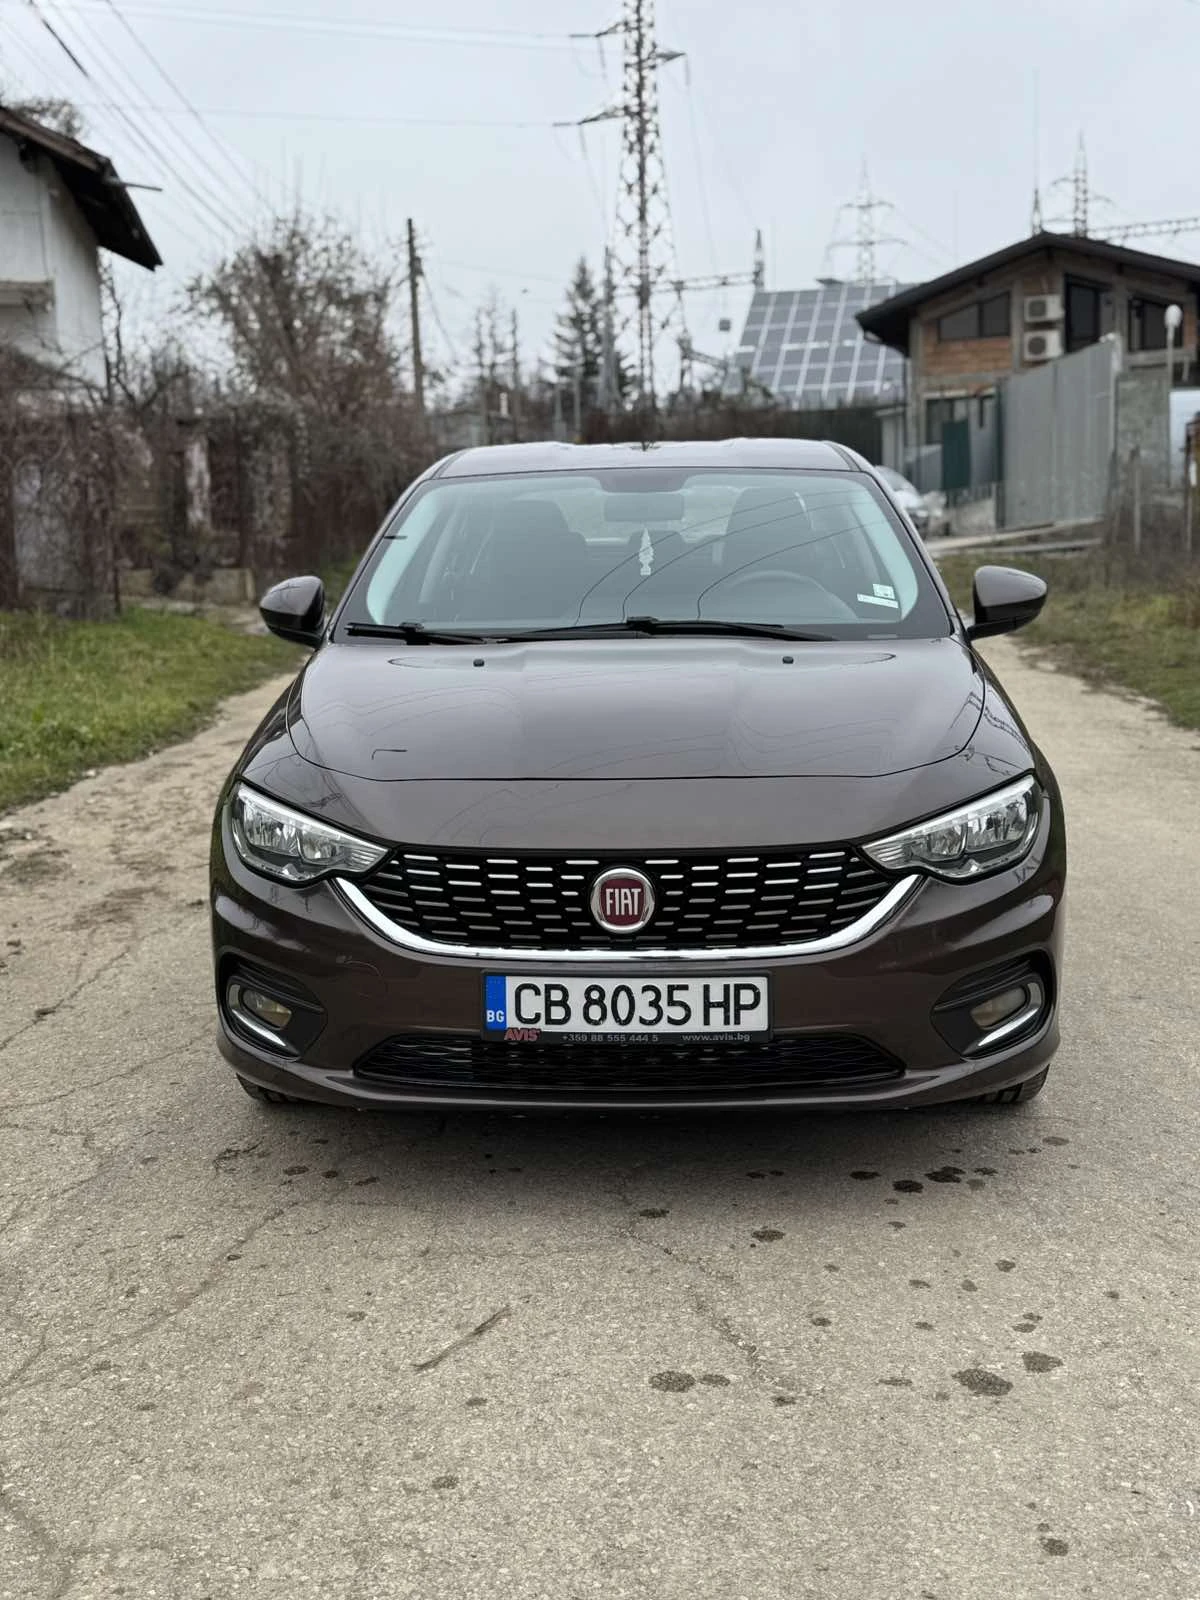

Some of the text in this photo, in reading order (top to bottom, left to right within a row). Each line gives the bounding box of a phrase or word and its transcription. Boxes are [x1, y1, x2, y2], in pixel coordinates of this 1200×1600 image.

[605, 888, 642, 916] FIAT
[514, 983, 761, 1026] CB 8035 HP
[486, 1010, 505, 1023] BG
[504, 1028, 541, 1041] AVIS
[562, 1034, 659, 1042] +359 88 555 444 5
[682, 1033, 750, 1042] www.avis.bg
